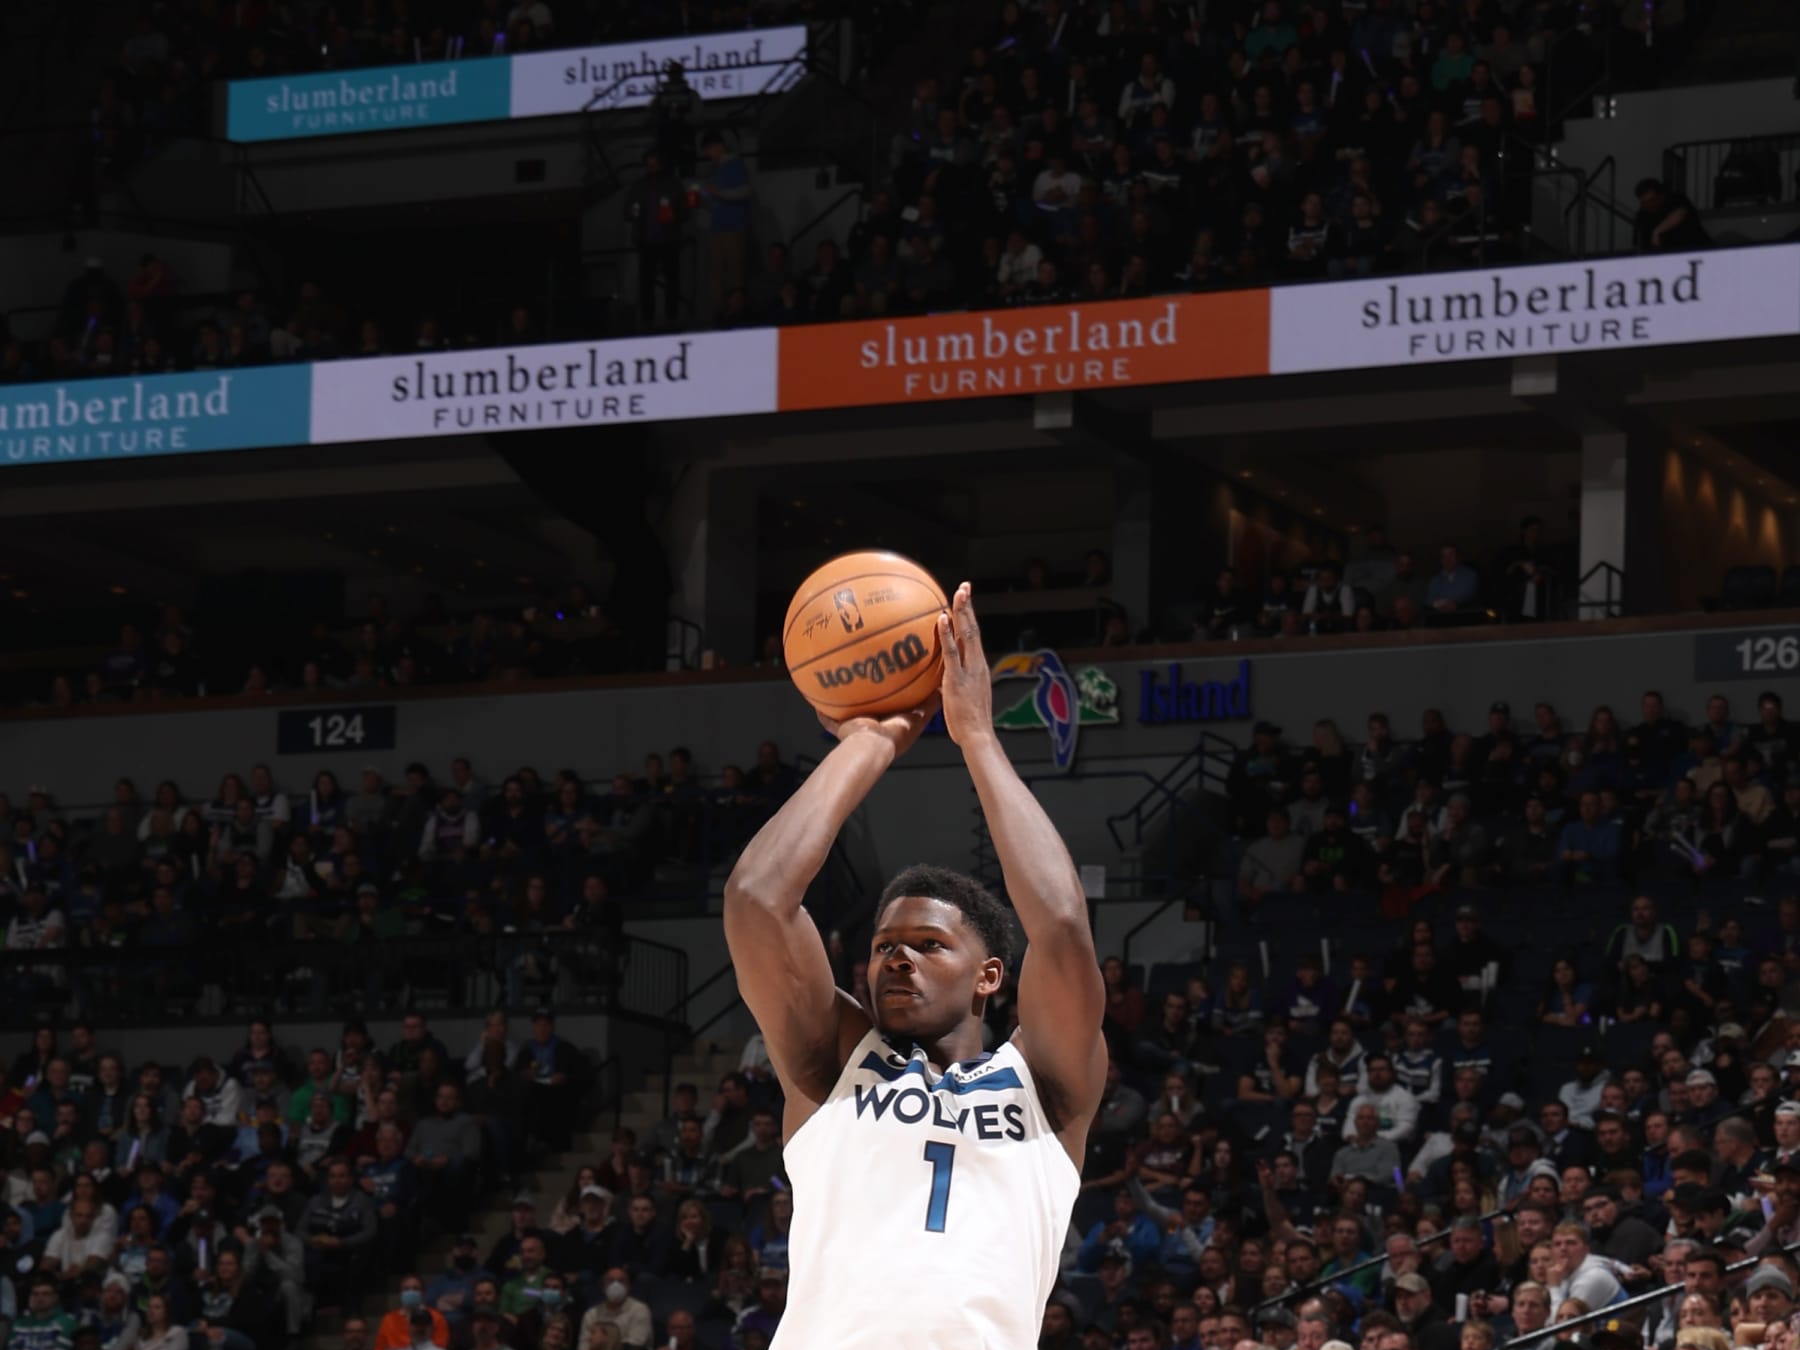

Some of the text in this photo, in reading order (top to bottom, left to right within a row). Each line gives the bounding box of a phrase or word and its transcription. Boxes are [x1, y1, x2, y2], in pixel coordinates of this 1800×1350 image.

[266, 69, 459, 113] slumberland
[292, 104, 429, 129] FURNITURE
[1362, 260, 1704, 329] slumberland
[861, 303, 1180, 369] slumberland
[1409, 316, 1652, 357] FURNITURE
[391, 342, 693, 402] slumberland
[905, 357, 1132, 395] FURNITURE
[433, 394, 647, 430] FURNITURE
[0, 426, 188, 460] URNITURE
[814, 633, 929, 690] Wilson
[1736, 636, 1799, 671] 126
[1138, 657, 1252, 726] Island
[308, 713, 366, 748] 124
[854, 1084, 1026, 1141] WOLVES
[923, 1139, 957, 1234] 1
